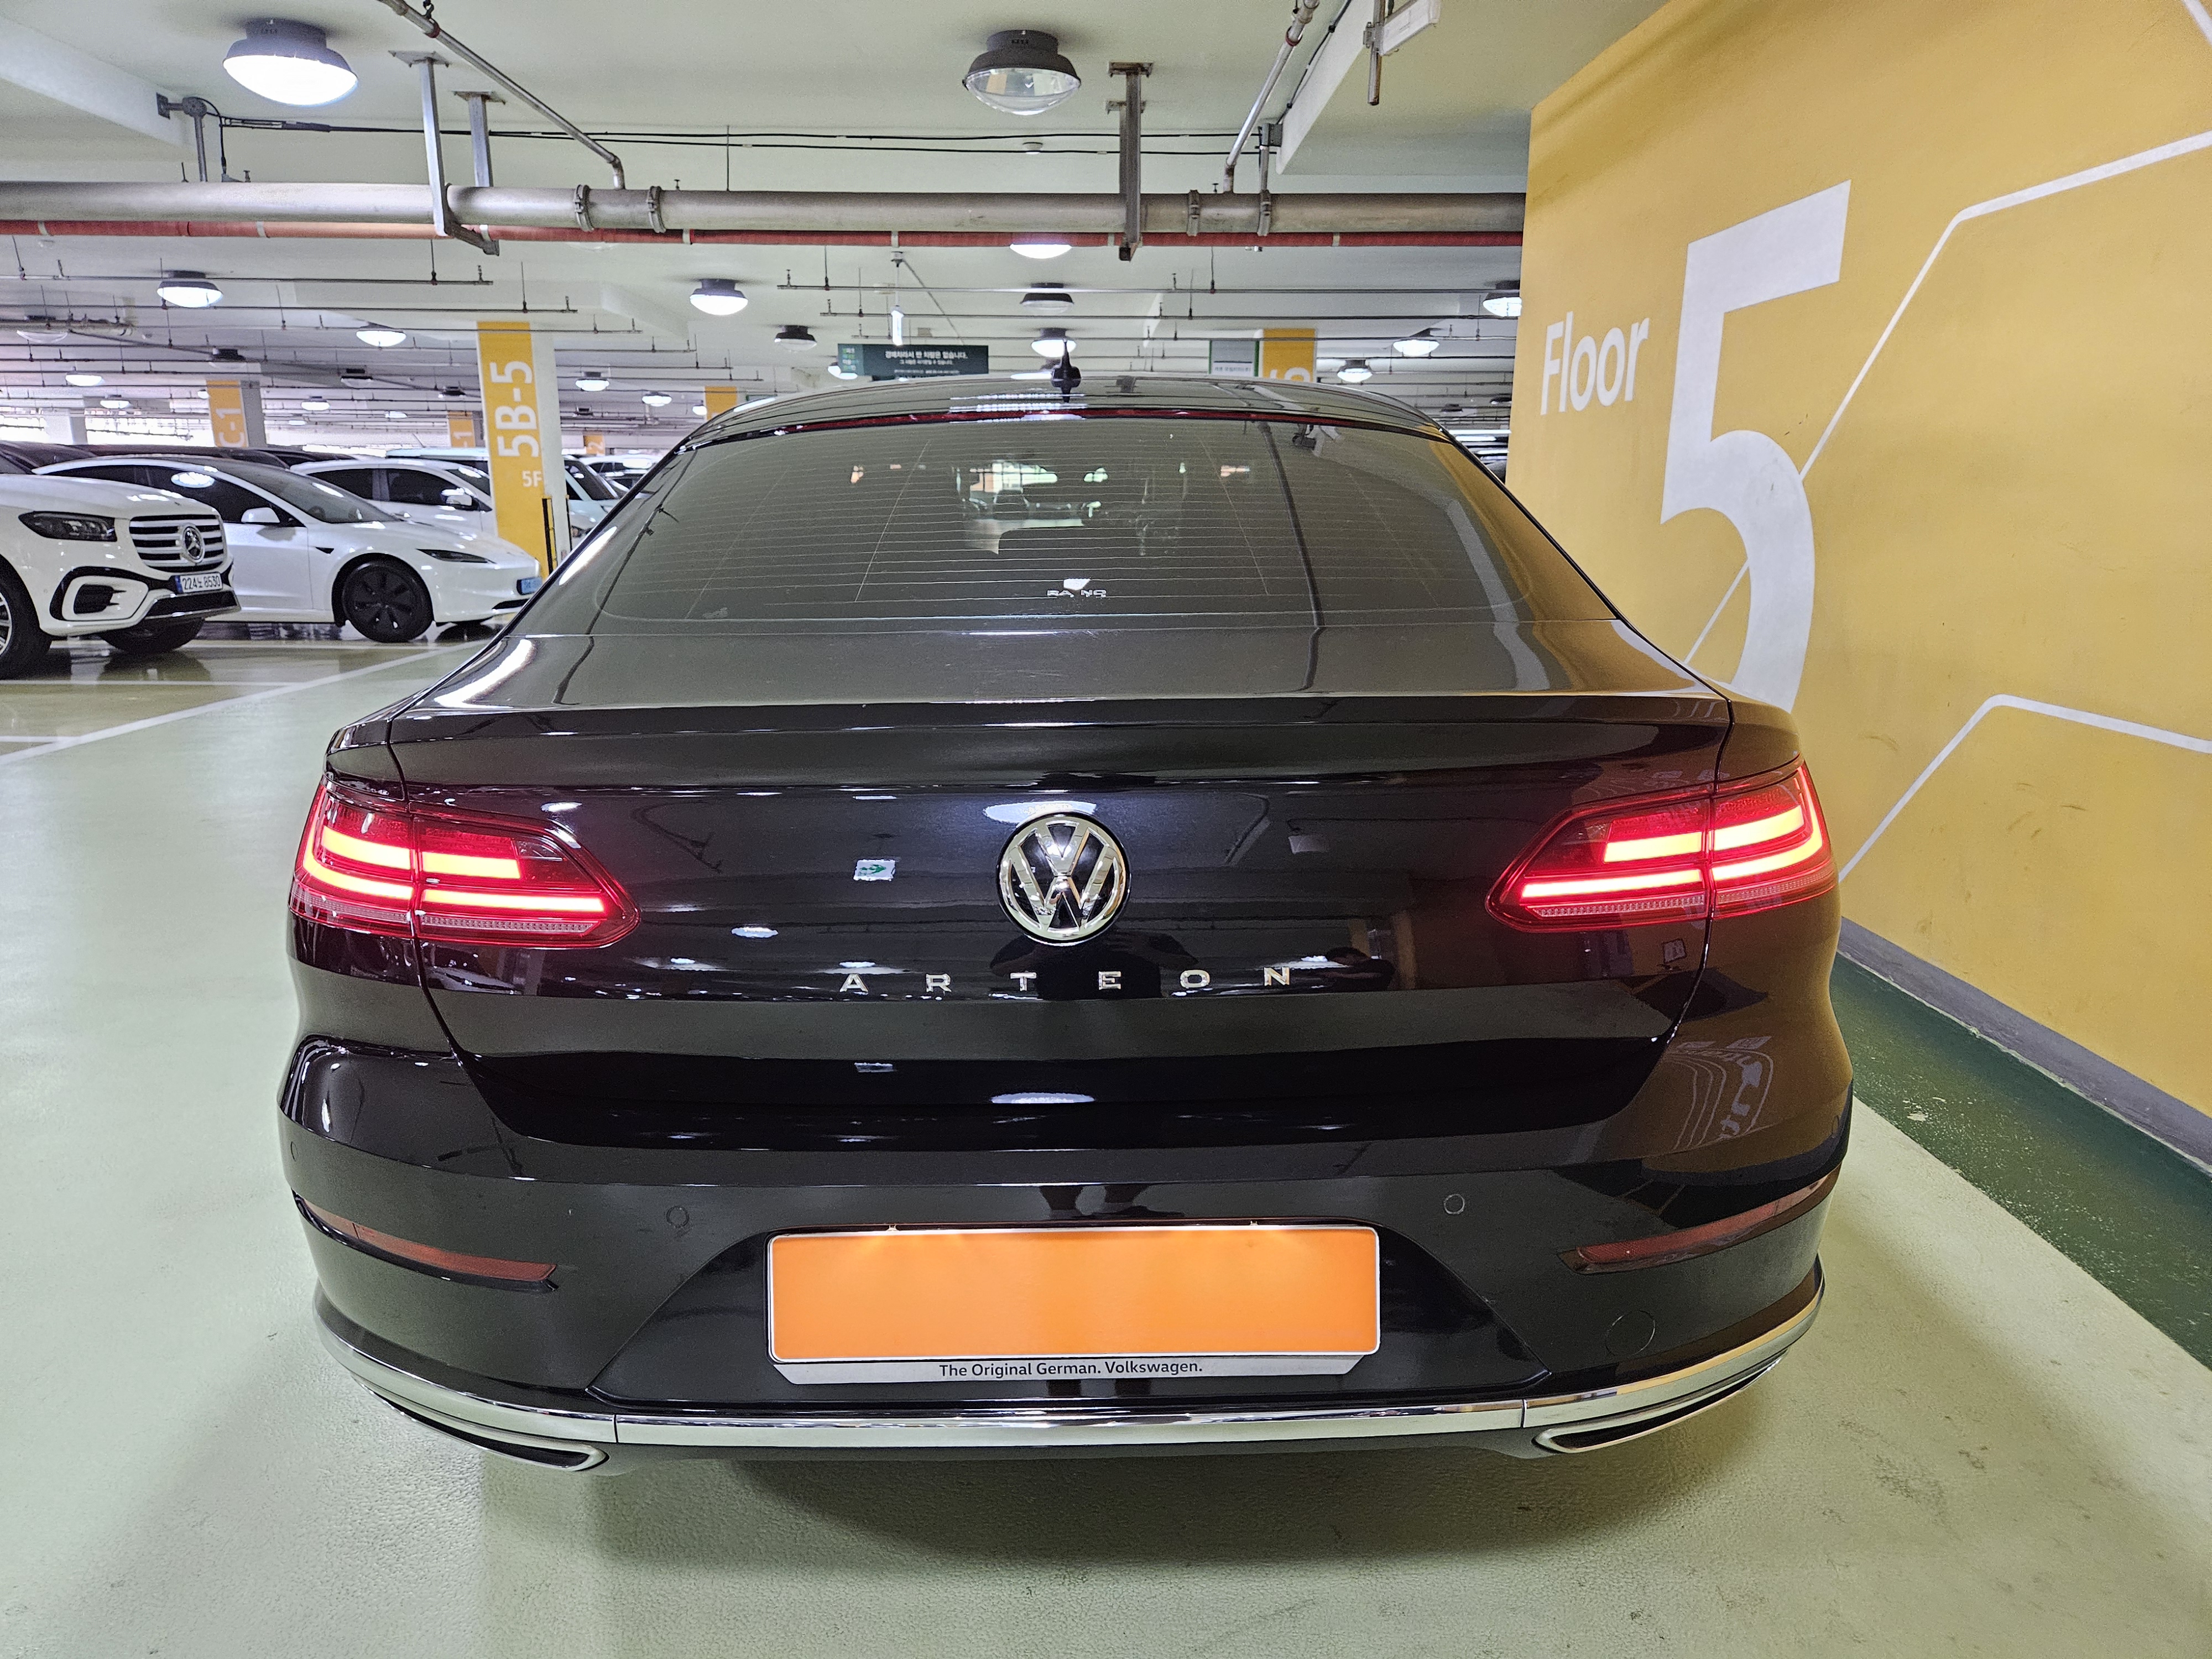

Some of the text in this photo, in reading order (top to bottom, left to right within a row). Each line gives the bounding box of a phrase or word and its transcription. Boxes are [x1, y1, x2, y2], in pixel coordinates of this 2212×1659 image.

[489, 361, 539, 457] 5B-5
[1540, 180, 1851, 713] Floor 5
[522, 471, 542, 487] 5F
[839, 967, 1290, 993] ARTEON
[940, 1360, 1203, 1378] The Original German. Volkswagen.
